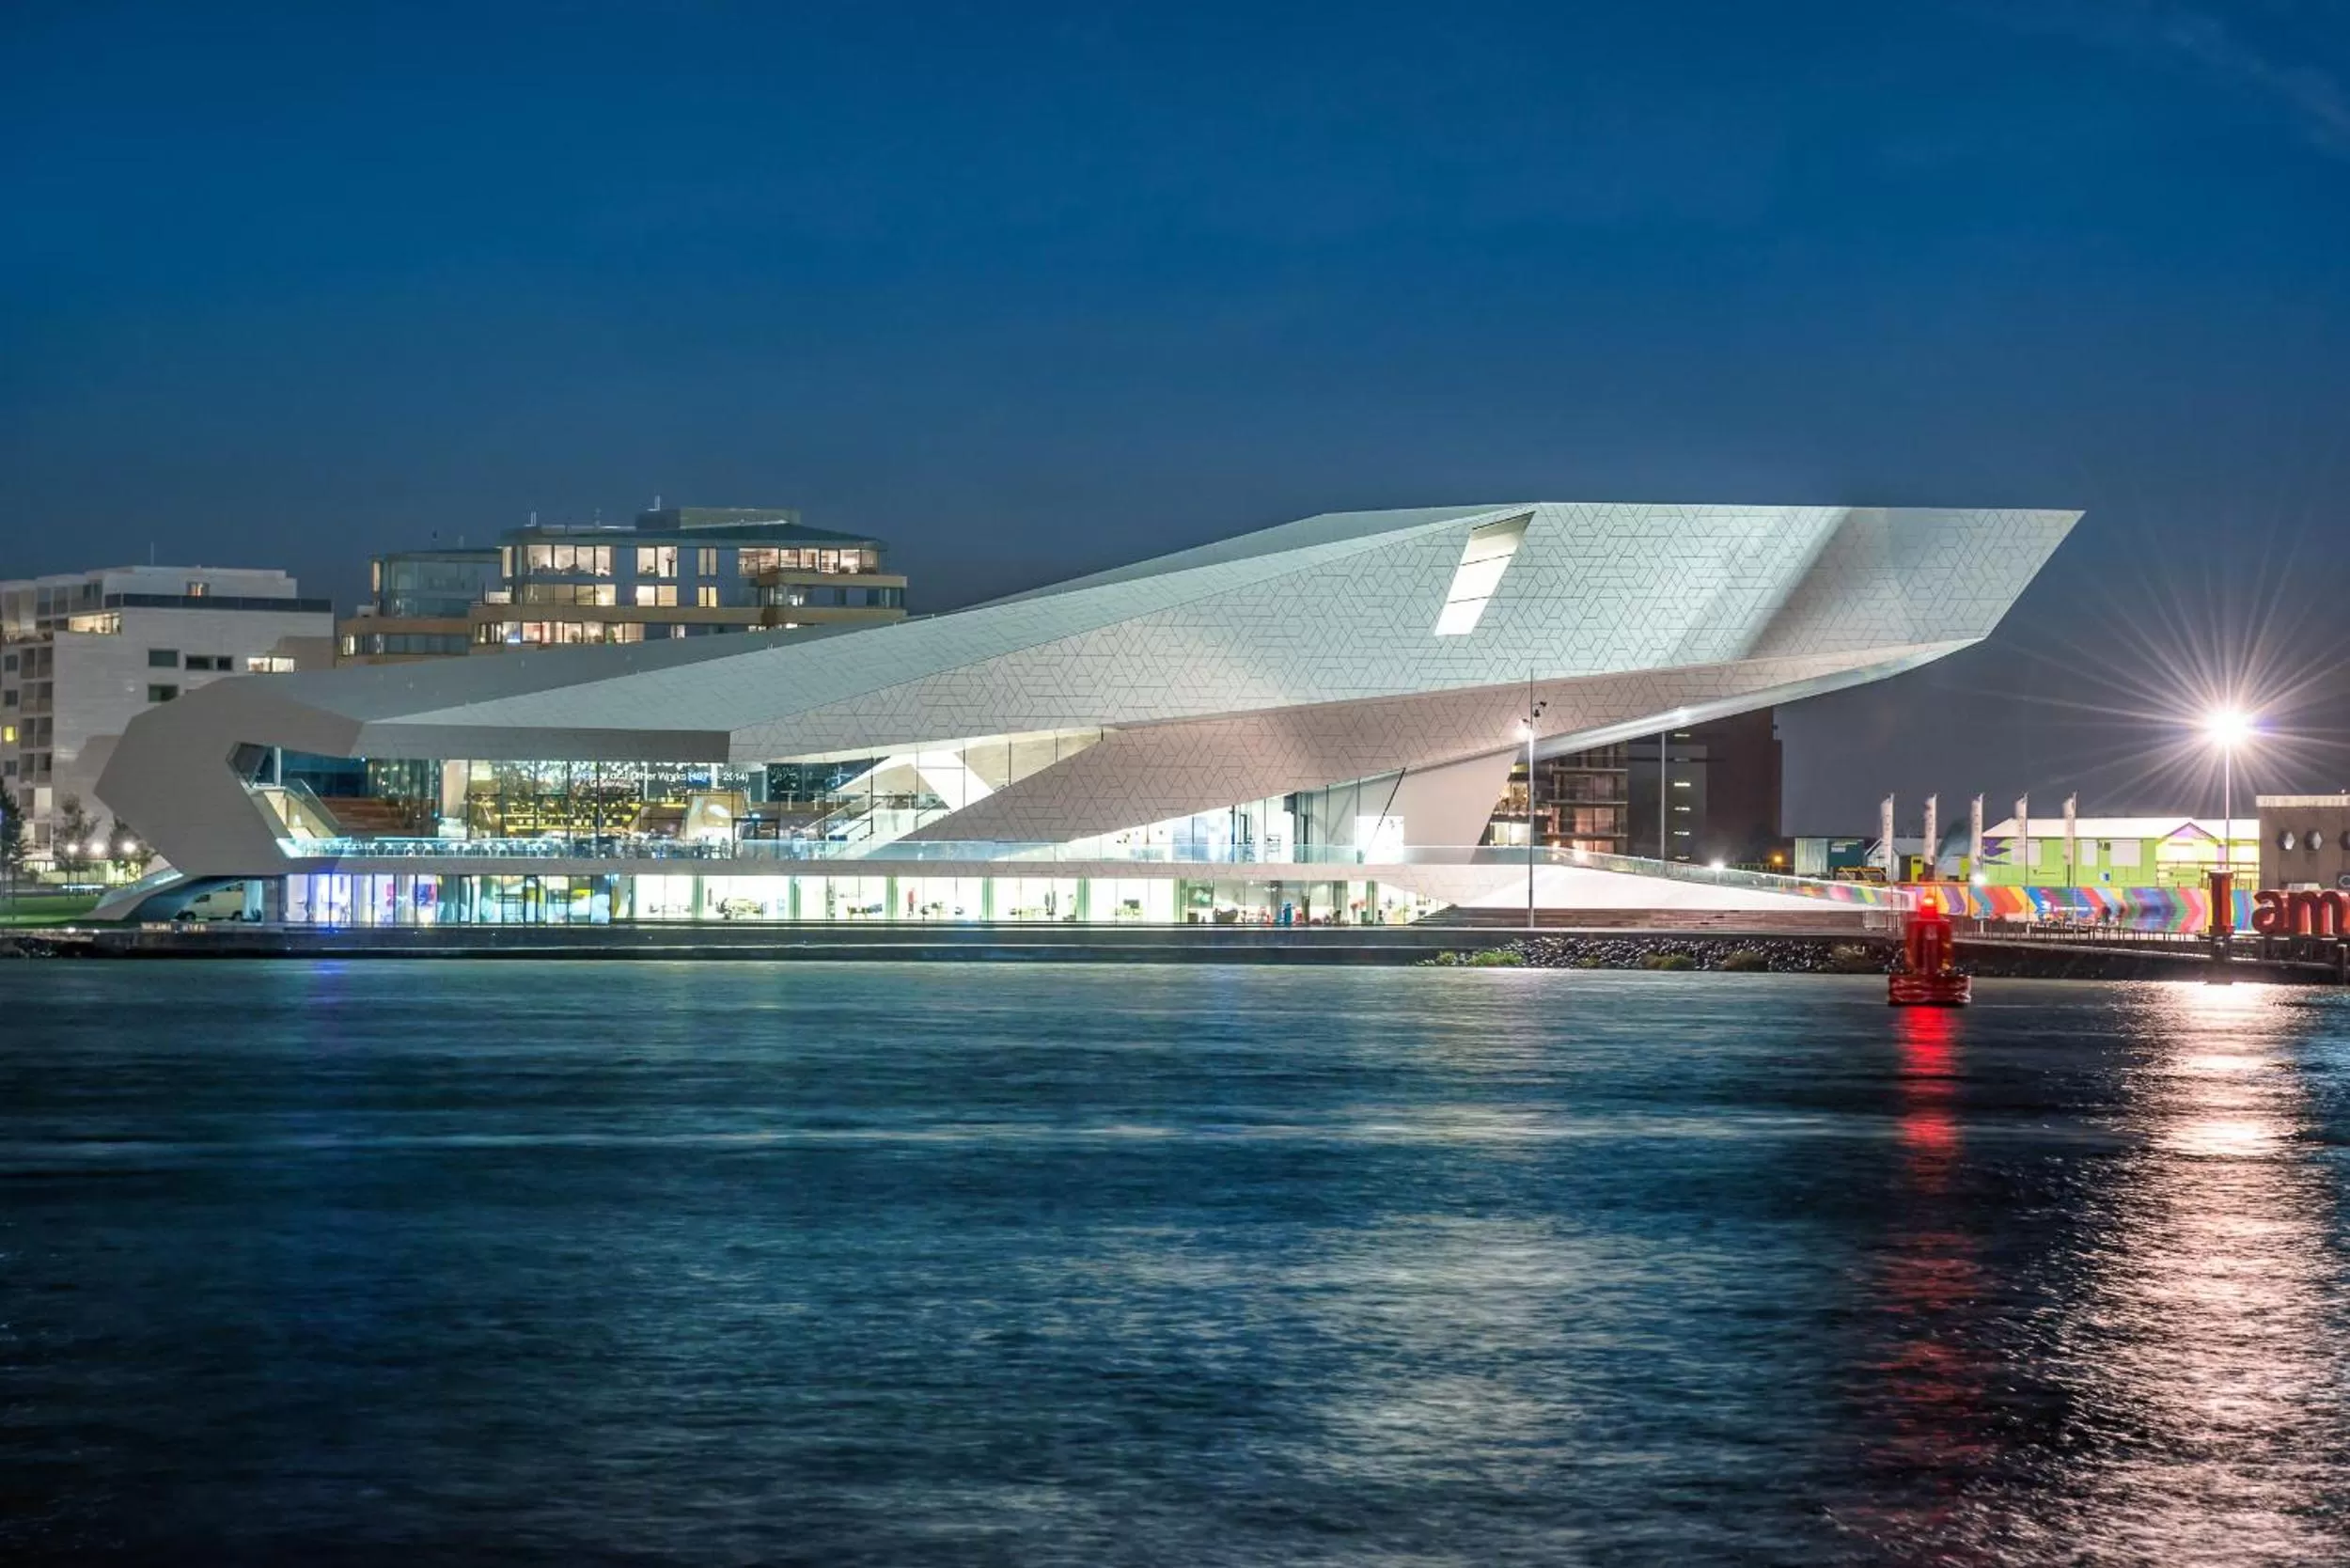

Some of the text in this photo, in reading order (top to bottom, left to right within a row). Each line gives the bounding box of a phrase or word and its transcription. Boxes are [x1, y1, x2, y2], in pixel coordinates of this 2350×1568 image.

[630, 771, 656, 780] Other
[658, 771, 687, 782] Works
[687, 771, 713, 782] (197
[722, 771, 750, 783] 2014)
[2209, 870, 2350, 936] I am
